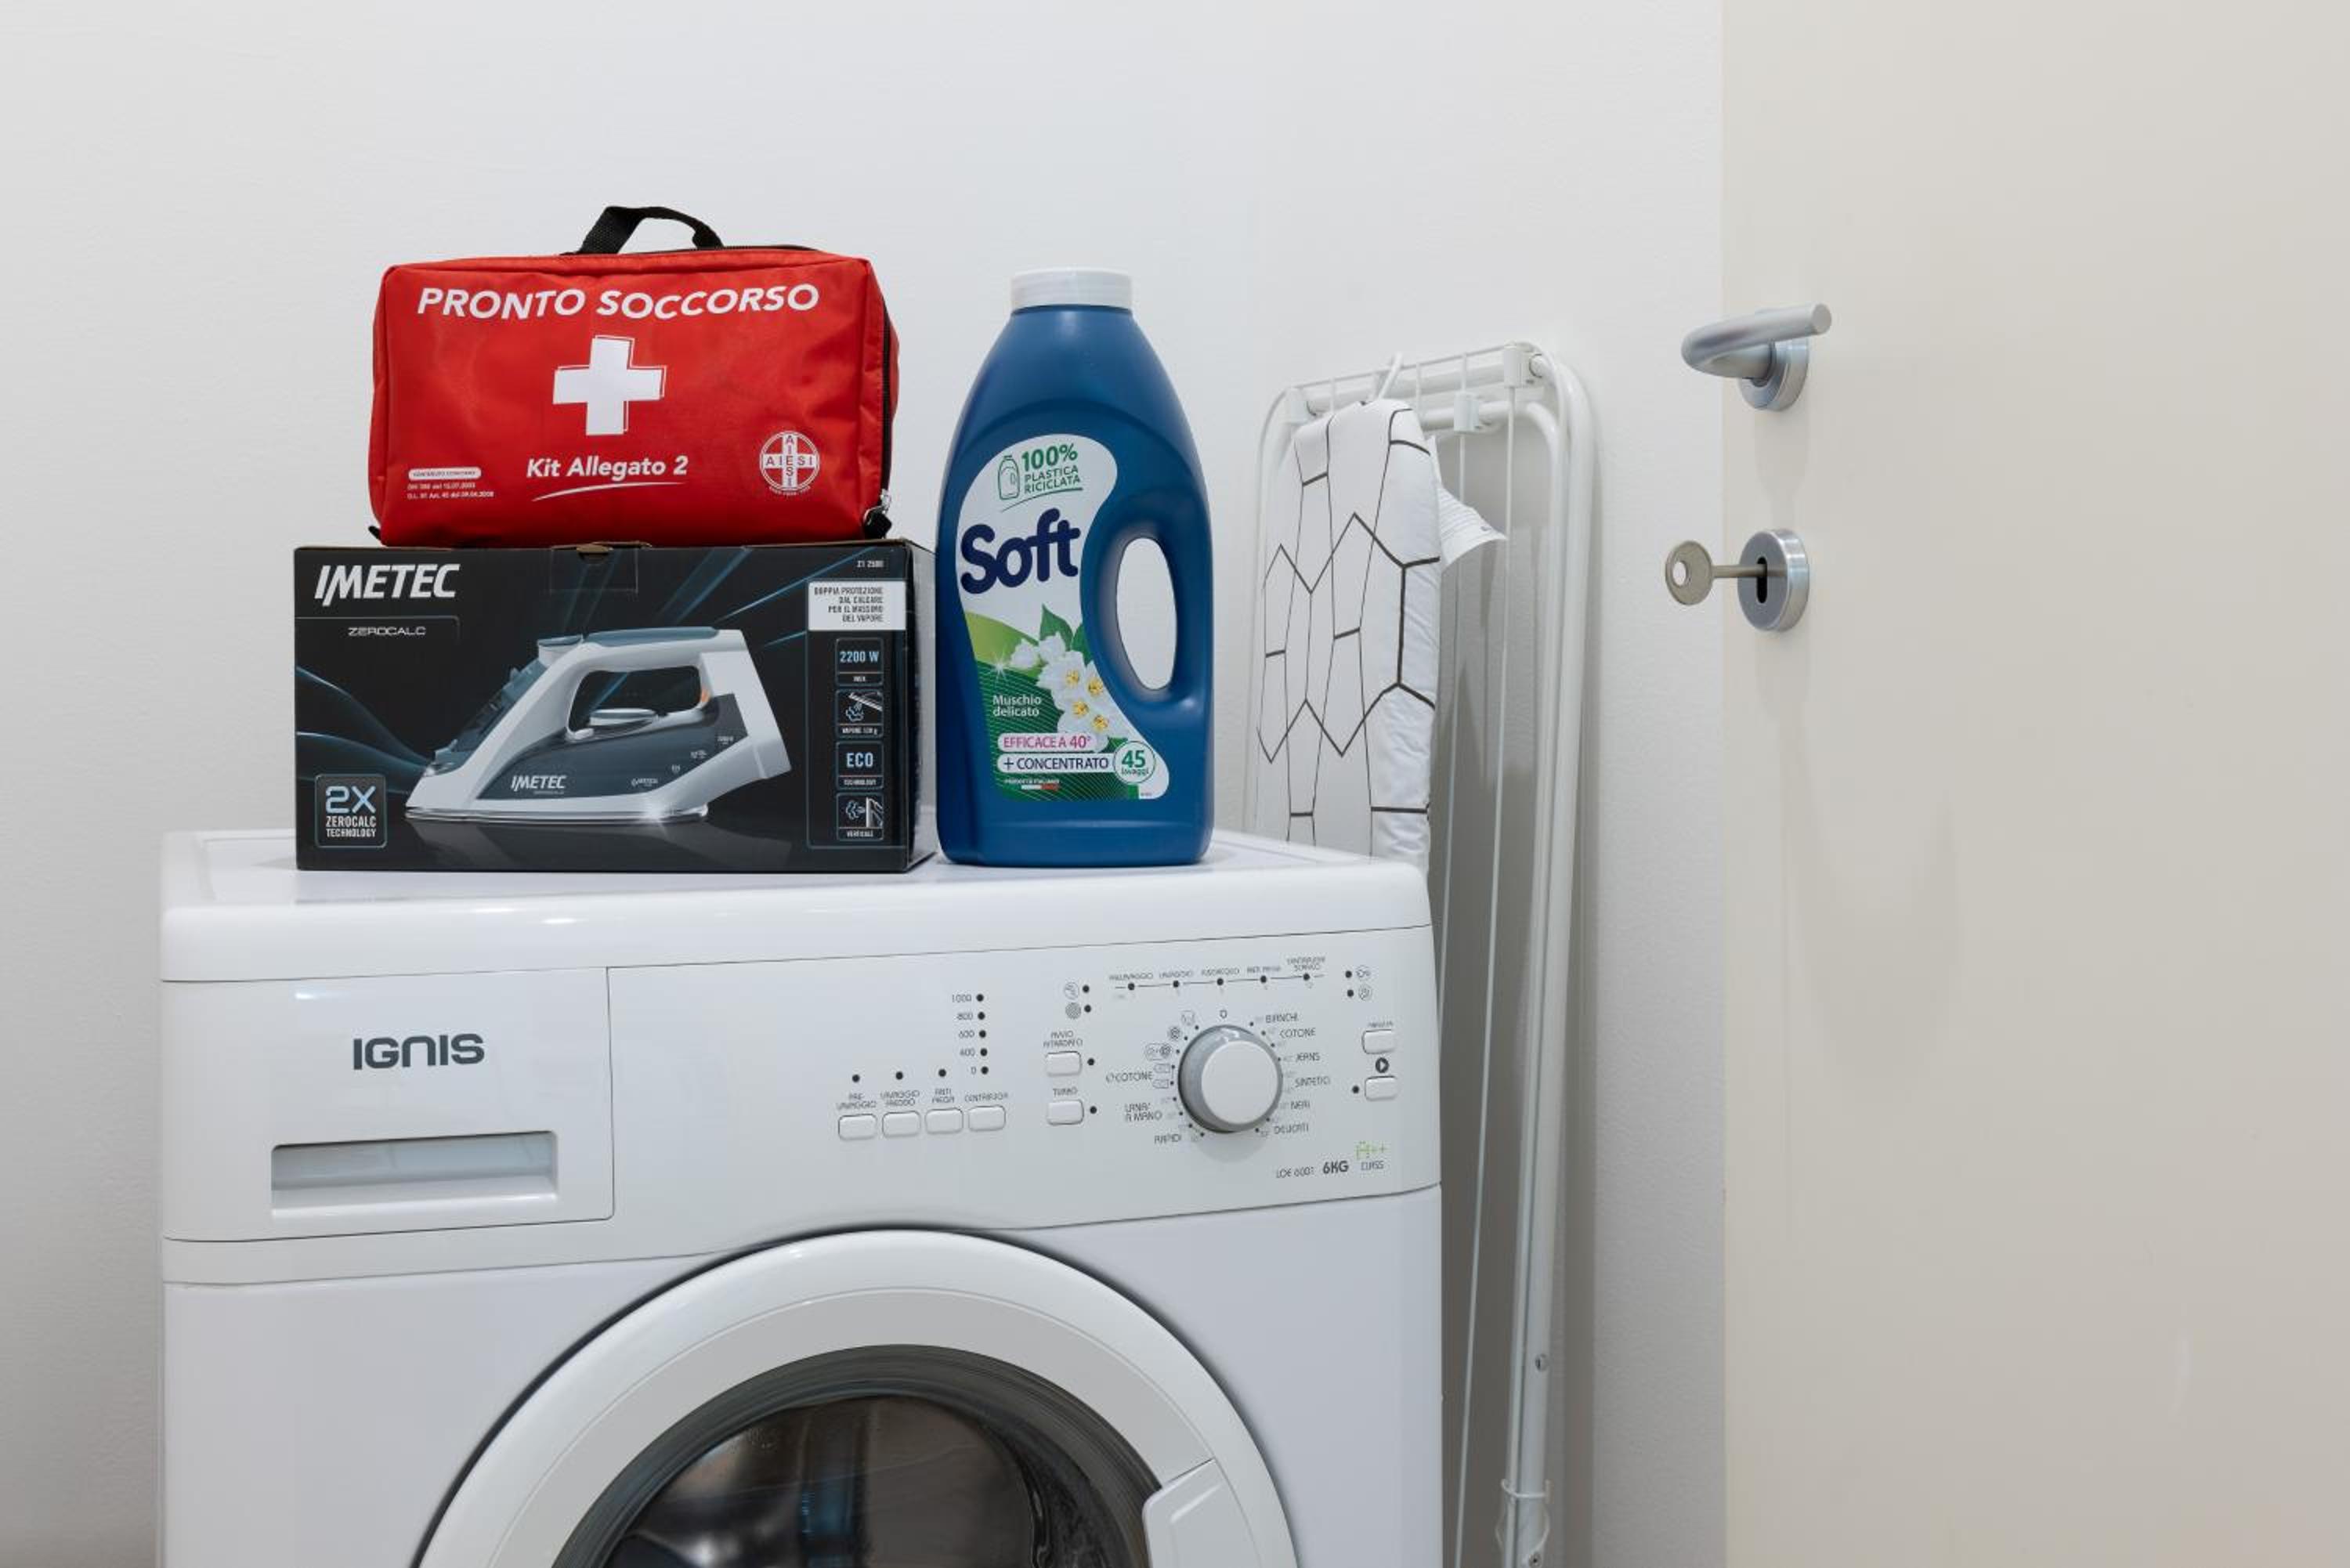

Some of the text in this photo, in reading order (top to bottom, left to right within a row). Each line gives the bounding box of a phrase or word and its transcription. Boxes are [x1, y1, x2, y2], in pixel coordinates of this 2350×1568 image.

[418, 284, 819, 320] PRONTO SOCCORSO
[766, 456, 812, 466] AIESI
[1021, 443, 1078, 471] 100%
[526, 455, 689, 482] Kit Allegato 2
[1025, 465, 1079, 482] PLASTICA
[1025, 475, 1080, 494] RICICLATA
[960, 508, 1081, 594] Soft
[314, 564, 461, 606] IMETEC
[348, 627, 426, 637] ZEROCALC
[840, 651, 880, 663] 2200 W
[992, 695, 1042, 706] Muschio
[992, 706, 1039, 717] delicato
[1003, 737, 1055, 748] EFFICACE
[1058, 736, 1067, 747] A
[847, 753, 873, 768] ECO
[1017, 757, 1109, 770] CONCENTRATO
[1121, 750, 1146, 768] 45
[511, 775, 567, 792] IMETEC
[326, 786, 376, 814] 2X
[326, 815, 376, 827] ZEROCALC
[326, 828, 376, 837] TECHNOLOGY
[952, 994, 972, 1003] 1000
[1265, 1013, 1298, 1023] BIANCHI
[1279, 1027, 1316, 1038] COTONE
[354, 1033, 485, 1070] IGNIS
[1296, 1052, 1320, 1062] JEANS
[1294, 1075, 1330, 1088] SINTETICI
[1053, 1086, 1078, 1096] TURBO
[1290, 1100, 1311, 1110] NERI
[1133, 1111, 1162, 1122] MANO
[1322, 1159, 1350, 1174] 6KG
[1361, 1160, 1384, 1172] CLASS
